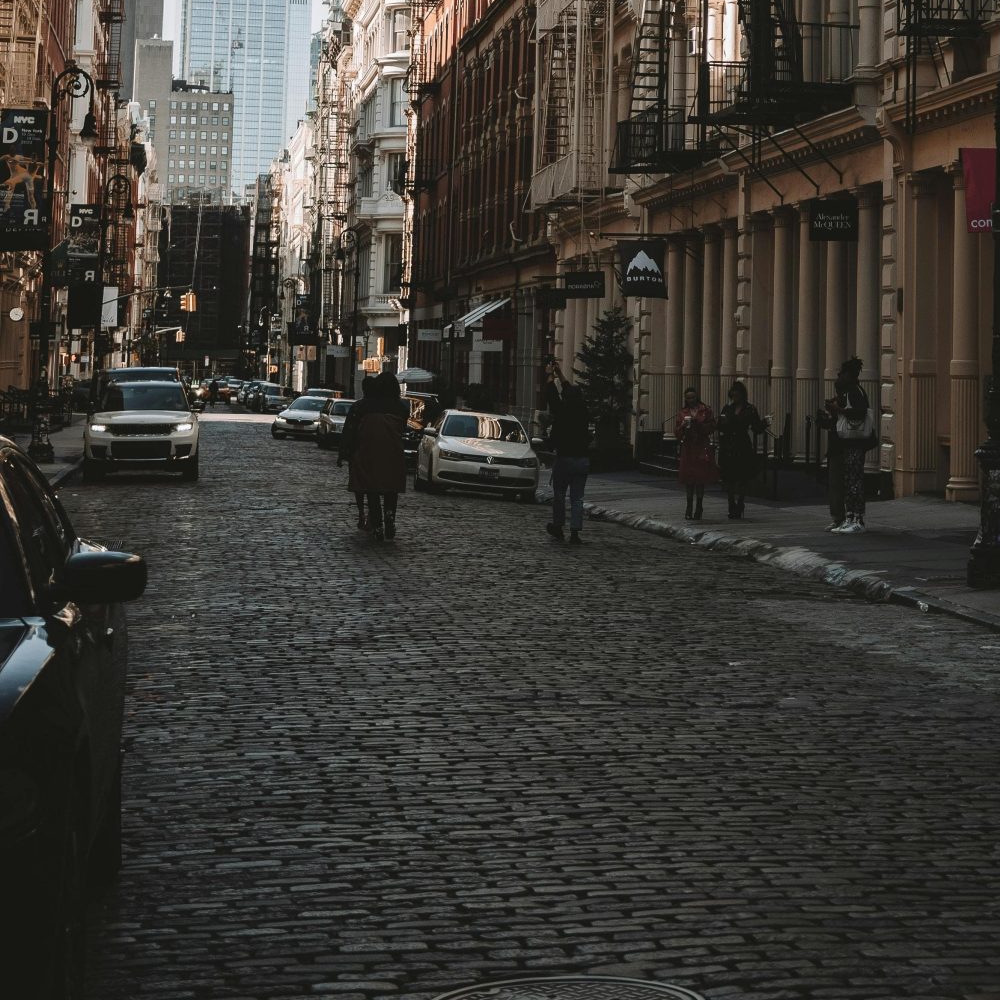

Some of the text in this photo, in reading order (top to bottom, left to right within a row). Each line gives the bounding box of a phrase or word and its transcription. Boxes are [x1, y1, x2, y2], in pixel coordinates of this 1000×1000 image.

[13, 116, 35, 124] NYC
[2, 127, 19, 144] D
[71, 215, 82, 227] D
